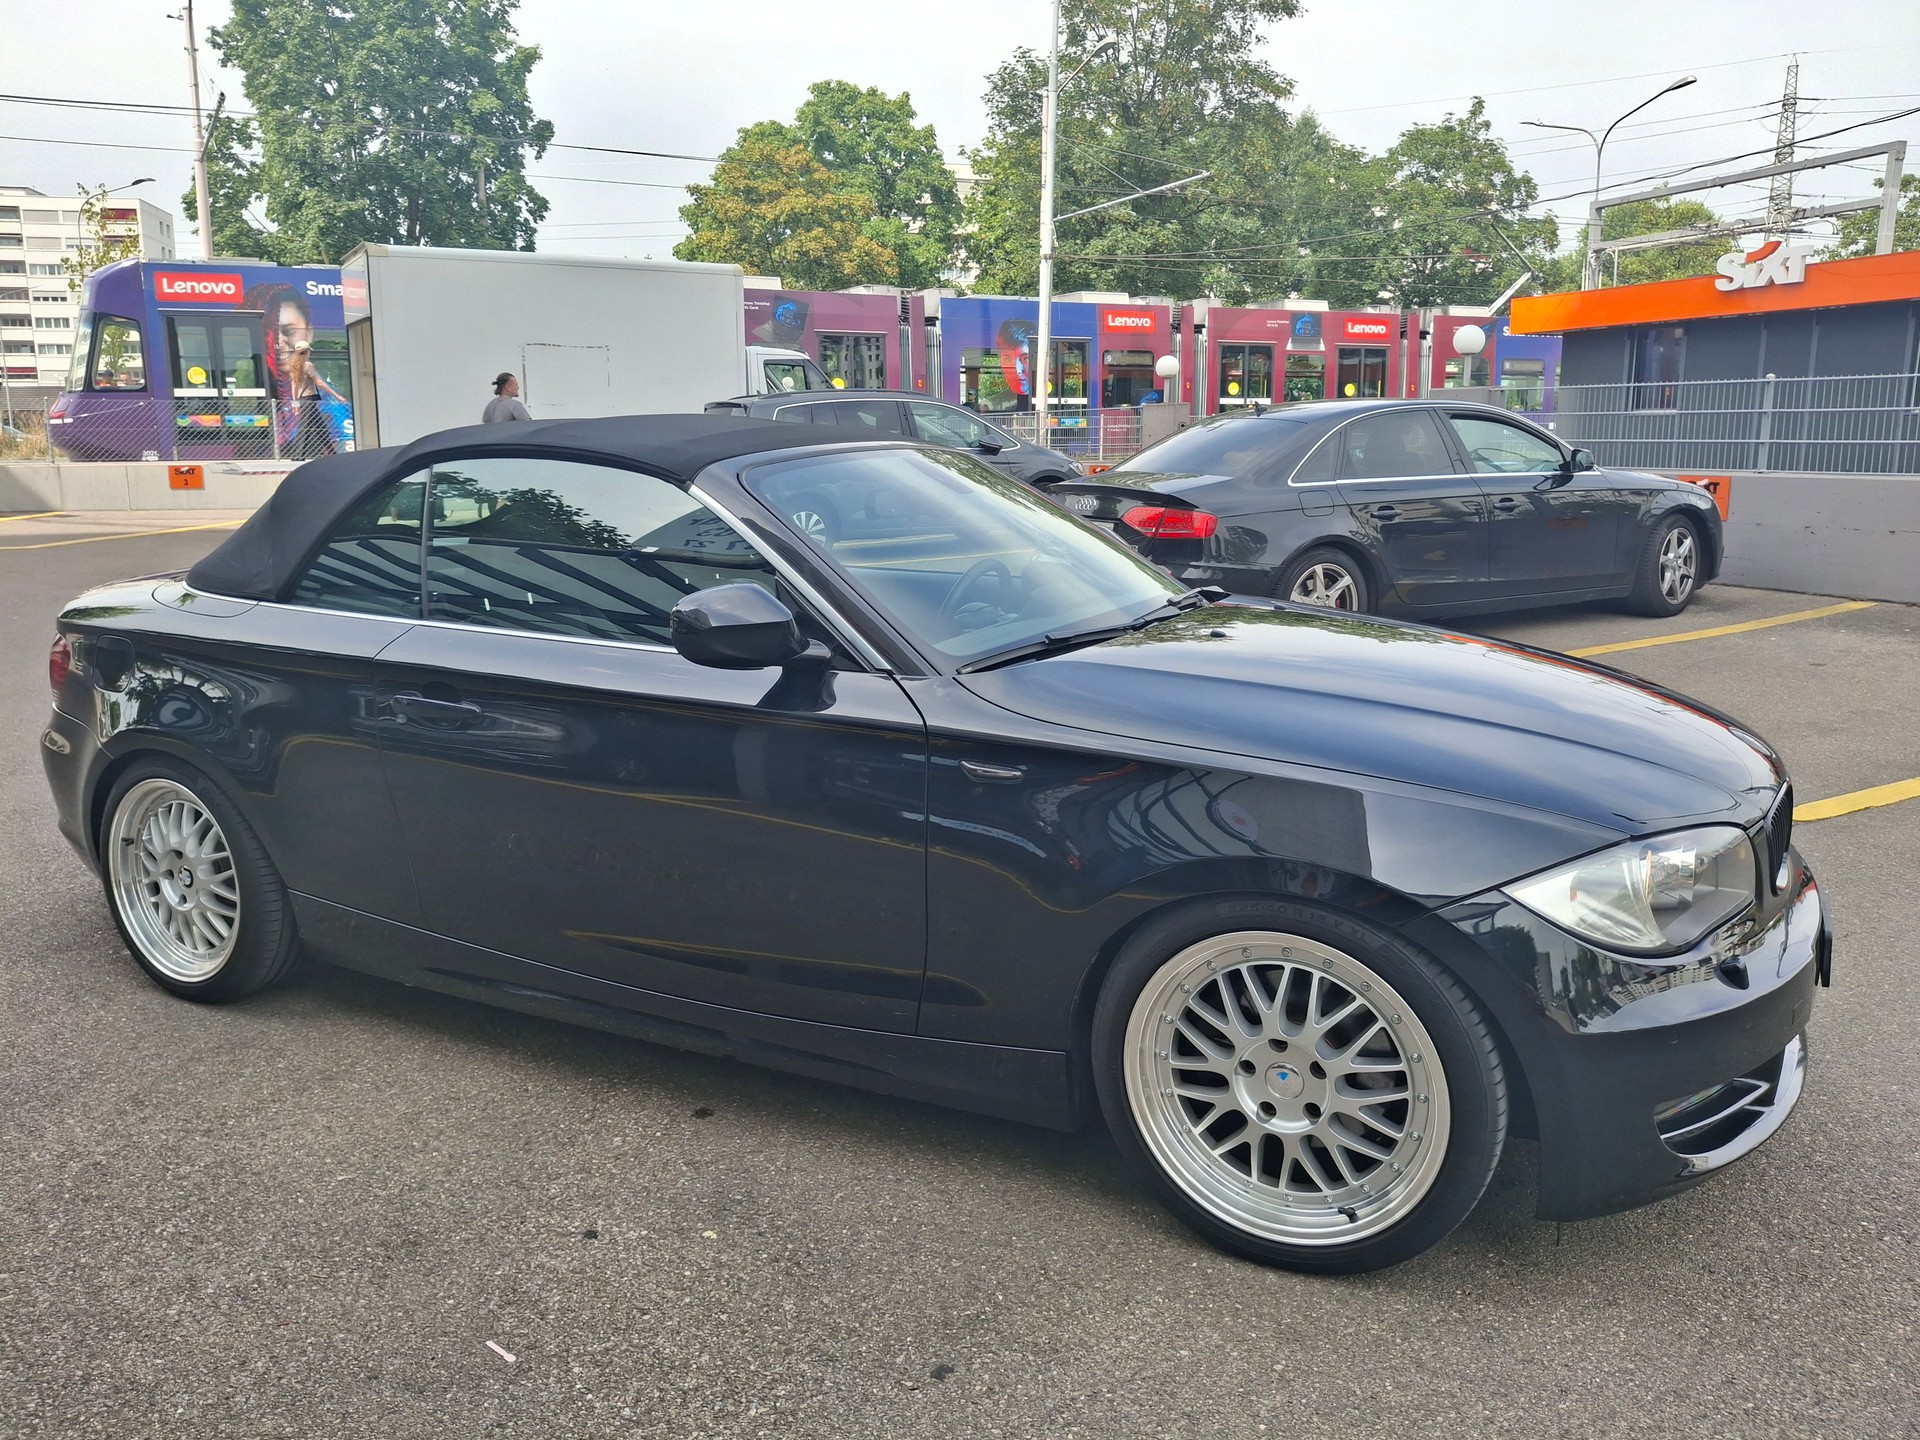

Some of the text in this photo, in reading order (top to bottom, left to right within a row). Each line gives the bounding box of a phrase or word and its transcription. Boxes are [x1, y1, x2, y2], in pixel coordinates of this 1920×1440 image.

[162, 278, 236, 295] Lenovo
[1108, 314, 1150, 327] Lenovo
[1347, 322, 1386, 334] Lenovo
[1106, 354, 1112, 363] 9
[183, 478, 189, 486] 3
